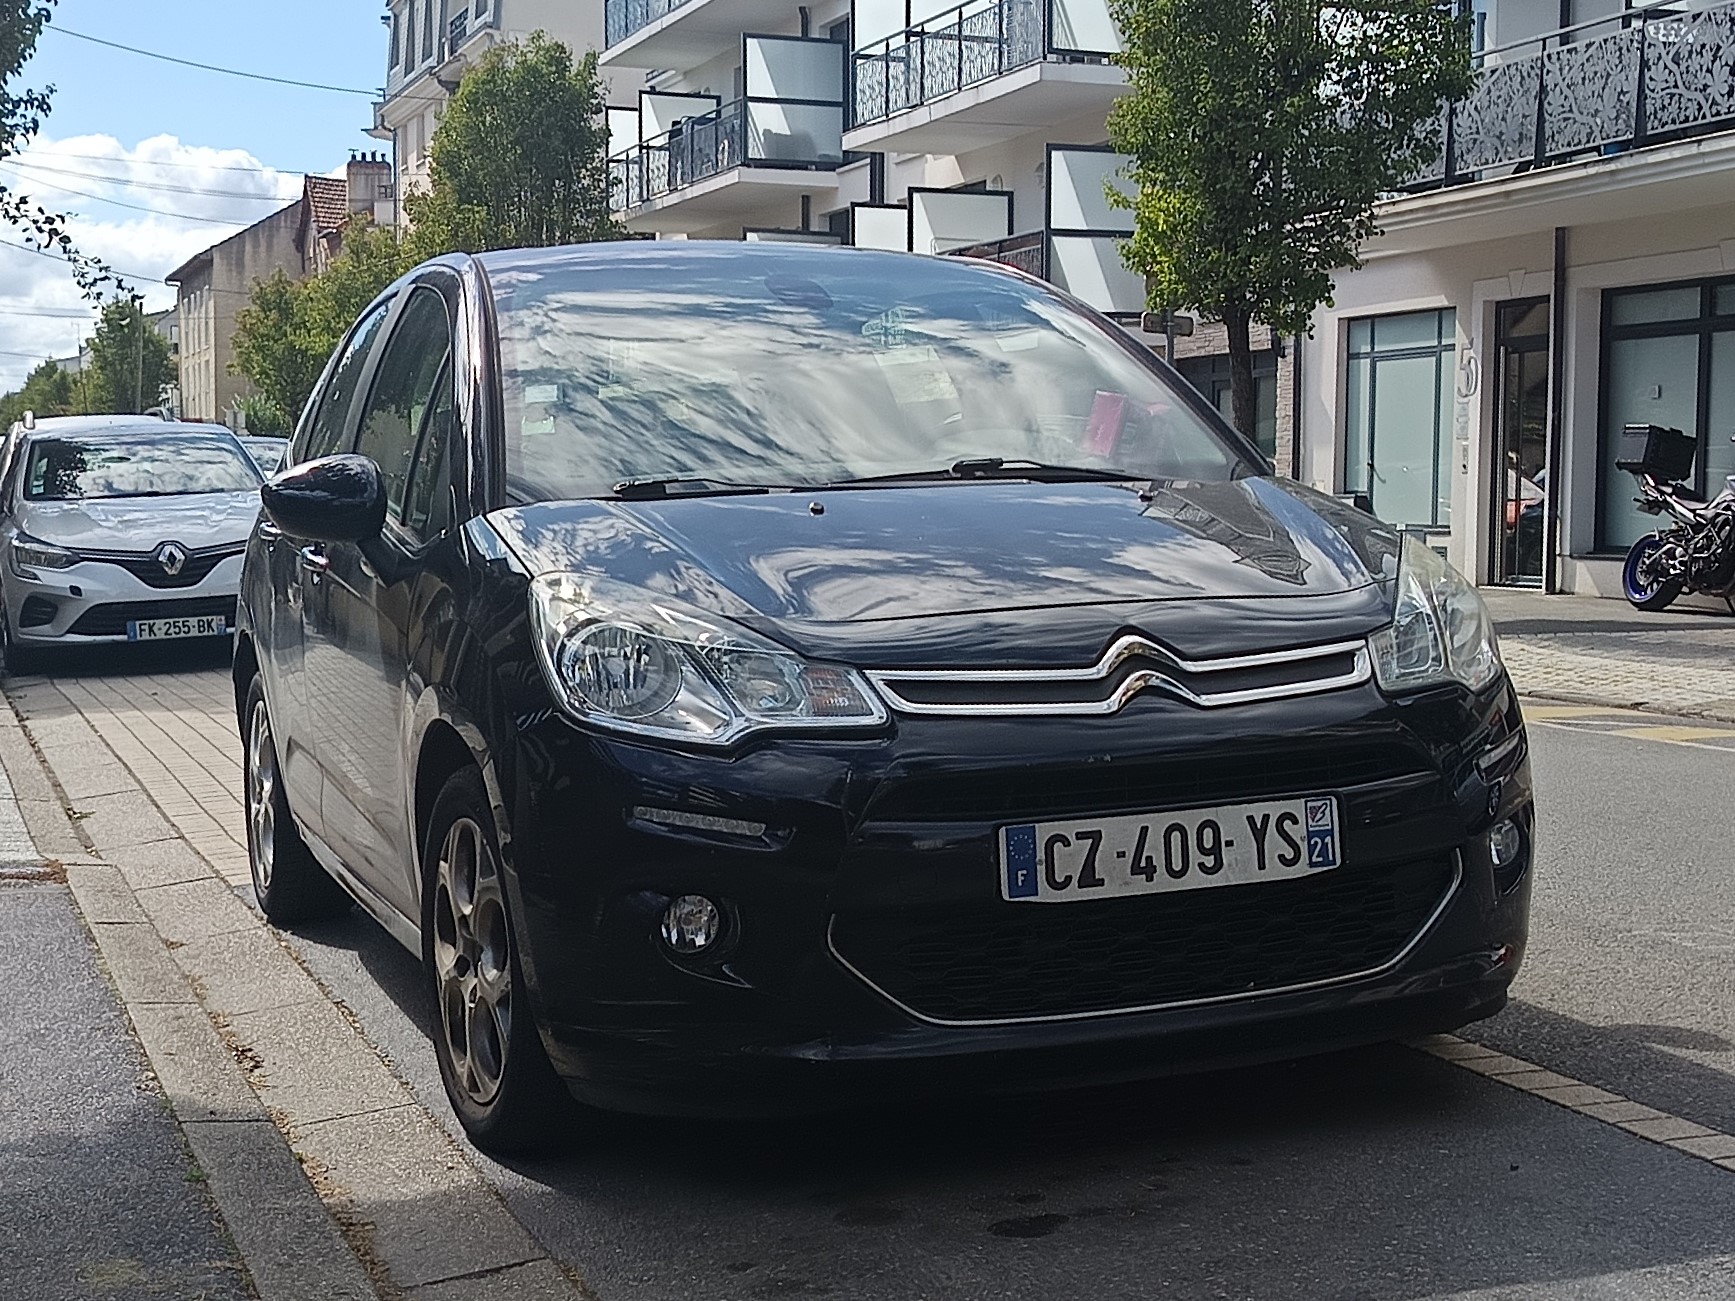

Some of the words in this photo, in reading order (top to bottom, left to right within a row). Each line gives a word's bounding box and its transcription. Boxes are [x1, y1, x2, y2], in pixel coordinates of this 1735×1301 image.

[138, 618, 215, 638] FK-255-BK
[1017, 870, 1027, 887] F
[1310, 836, 1334, 863] 21
